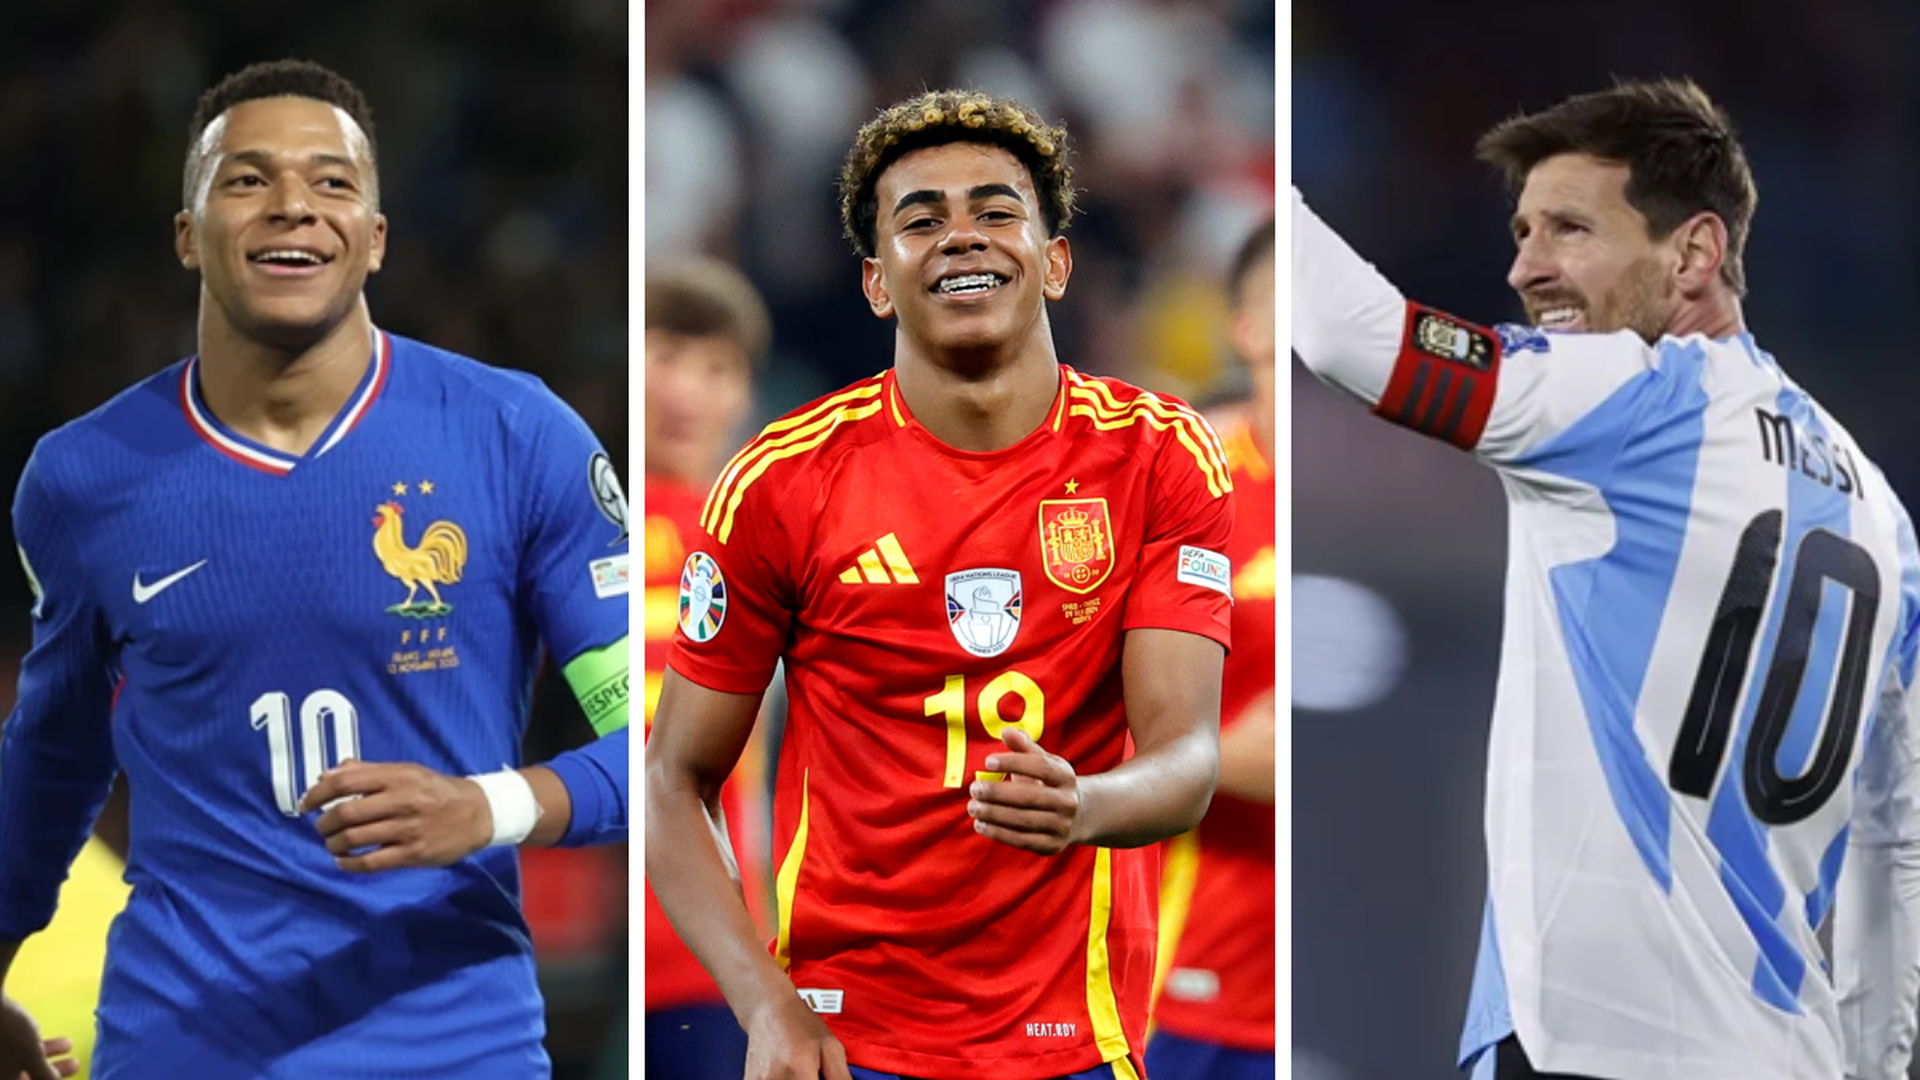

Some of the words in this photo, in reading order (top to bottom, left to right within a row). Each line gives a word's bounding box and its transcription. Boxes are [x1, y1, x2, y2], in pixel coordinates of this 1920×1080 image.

[1755, 406, 1864, 501] MESSI
[1182, 548, 1204, 558] UEFA
[1669, 509, 1881, 826] 10
[249, 688, 364, 818] 10
[1026, 1022, 1077, 1038] HEAT.RDY
